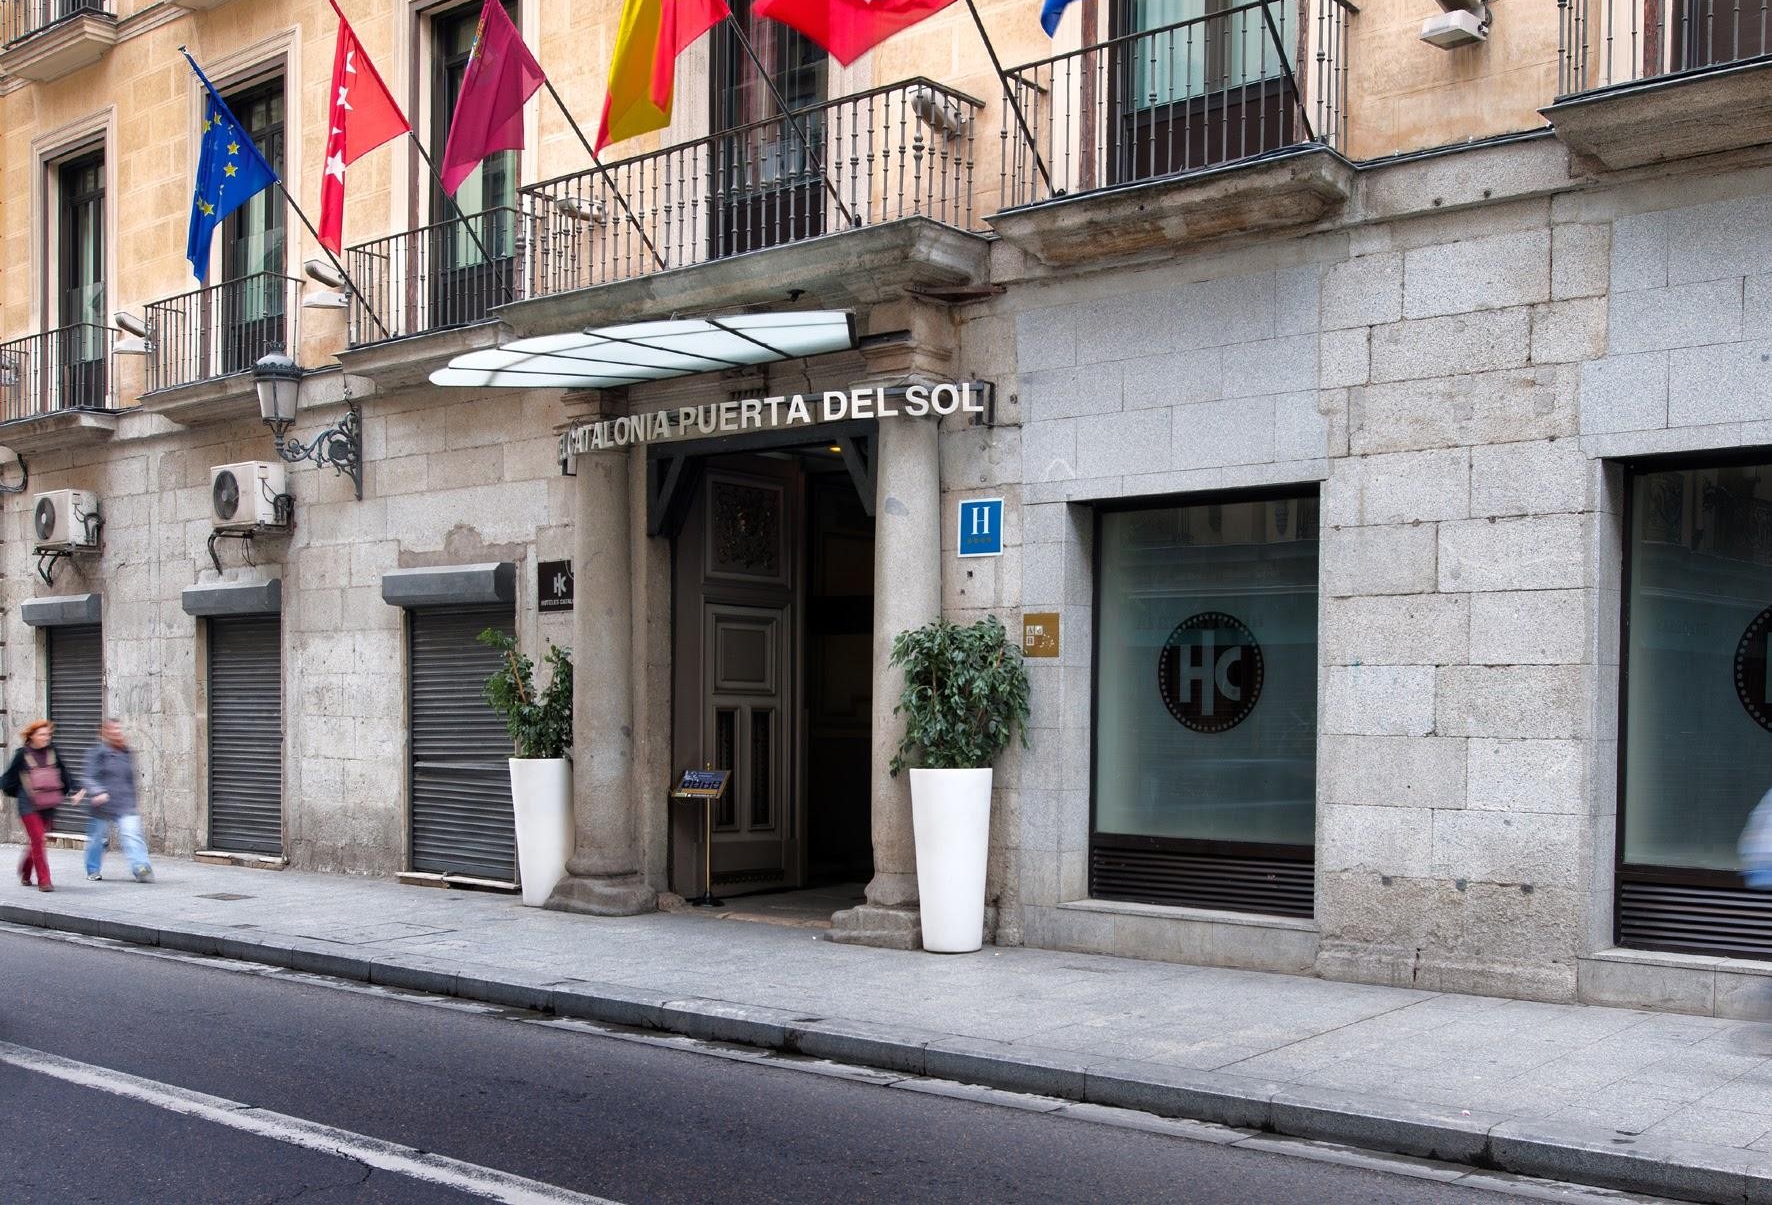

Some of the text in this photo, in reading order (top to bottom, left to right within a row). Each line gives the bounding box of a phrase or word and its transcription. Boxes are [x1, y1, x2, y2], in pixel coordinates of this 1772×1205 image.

[567, 410, 672, 458] CATALONIA
[679, 394, 811, 436] PUERTA
[823, 387, 899, 422] DEL
[905, 382, 984, 417] SOL
[970, 505, 991, 536] H
[1180, 629, 1242, 716] HC
